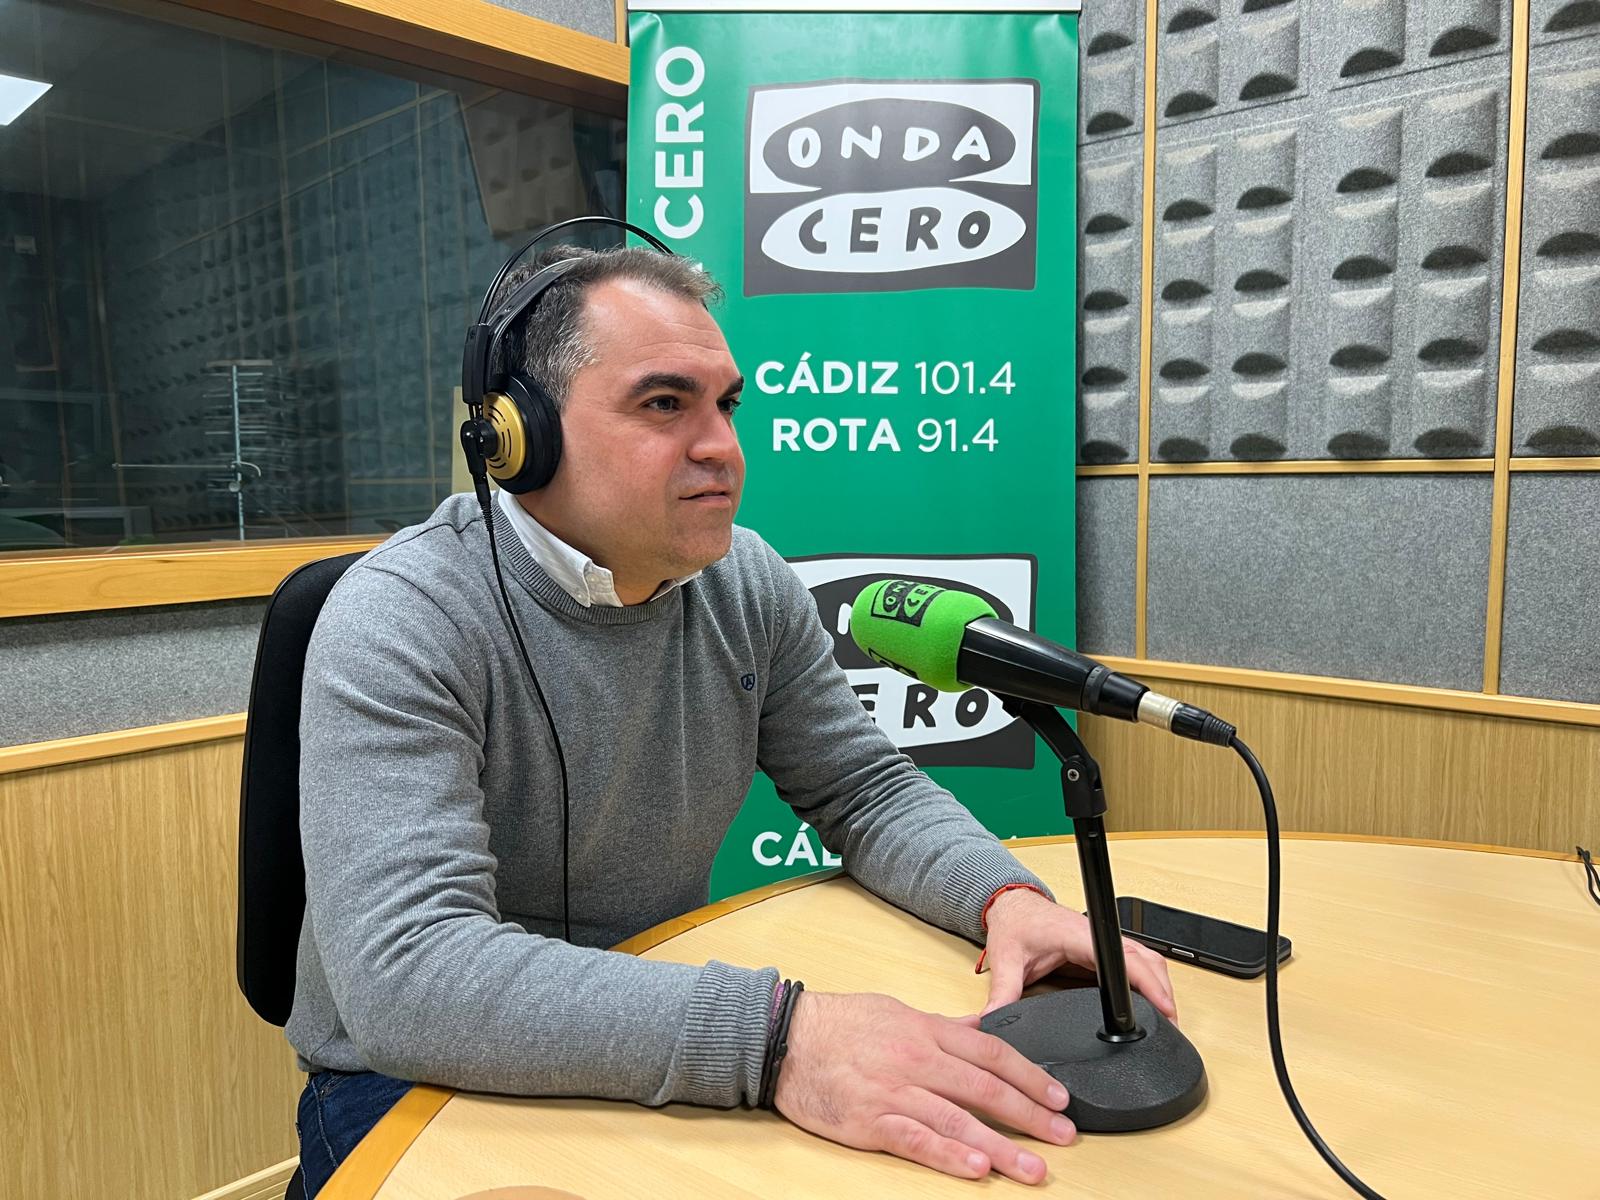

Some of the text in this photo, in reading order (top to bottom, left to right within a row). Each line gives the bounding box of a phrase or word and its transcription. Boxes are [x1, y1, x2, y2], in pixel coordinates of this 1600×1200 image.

[654, 46, 705, 239] CERO
[788, 125, 991, 168] ONDA
[799, 206, 991, 254] CERO
[755, 351, 1016, 394] CÁDIZ 101.4
[772, 418, 999, 452] ROTA 91.4
[850, 683, 990, 728] ERO
